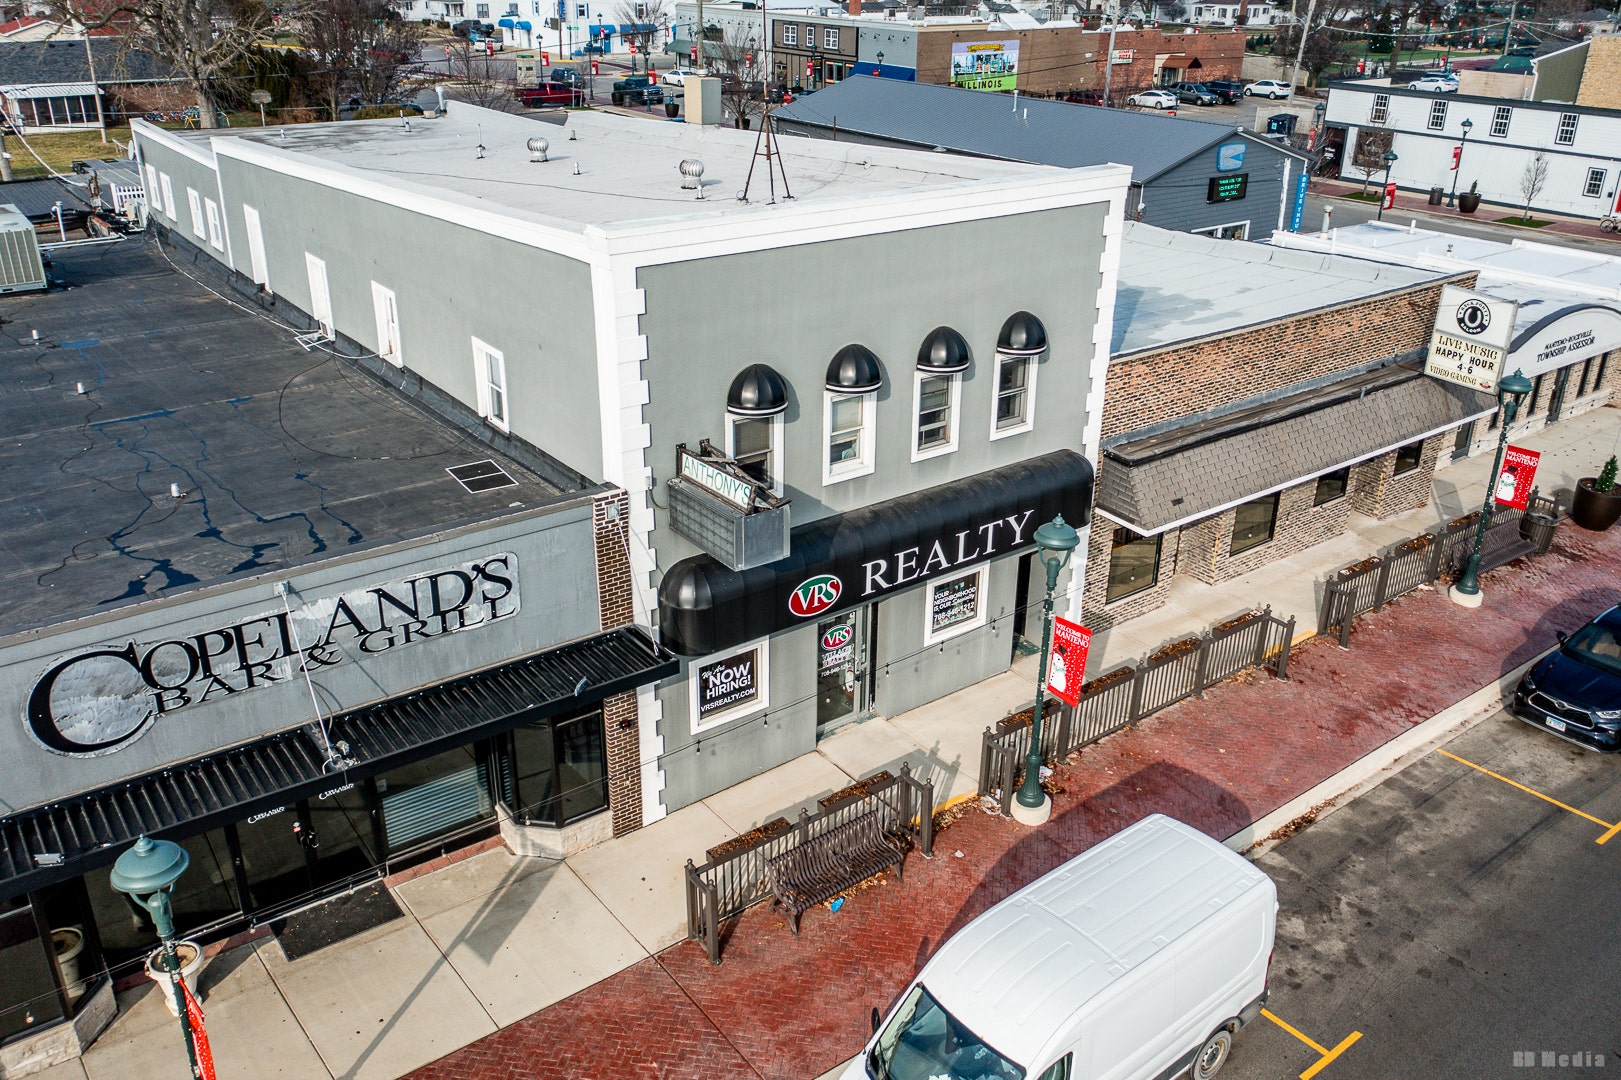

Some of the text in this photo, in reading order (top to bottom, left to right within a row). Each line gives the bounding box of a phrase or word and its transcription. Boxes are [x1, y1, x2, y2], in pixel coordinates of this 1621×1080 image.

[1298, 176, 1307, 204] DRIVE
[1435, 346, 1495, 371] HAPPY HOUR
[1438, 335, 1498, 360] LIVE MUSIC
[1536, 345, 1567, 363] TOWNSHIP
[1430, 365, 1477, 386] VIDEO GAMING
[1457, 363, 1473, 375] 4-6
[1506, 454, 1538, 467] MANTENO
[683, 456, 751, 507] ANTHONY'S
[796, 509, 1035, 611] VRS REALTY
[934, 590, 950, 600] YOUR
[939, 601, 952, 610] OUR
[827, 626, 849, 646] VRS
[1055, 627, 1089, 648] MANTENO
[1056, 622, 1090, 641] WELCOME TO
[27, 554, 514, 753] COPELAND'S
[151, 598, 518, 718] BAR & GRILL
[706, 674, 752, 700] HIRING!
[709, 661, 751, 689] NOW
[700, 687, 756, 712] VRSREALTY.COM
